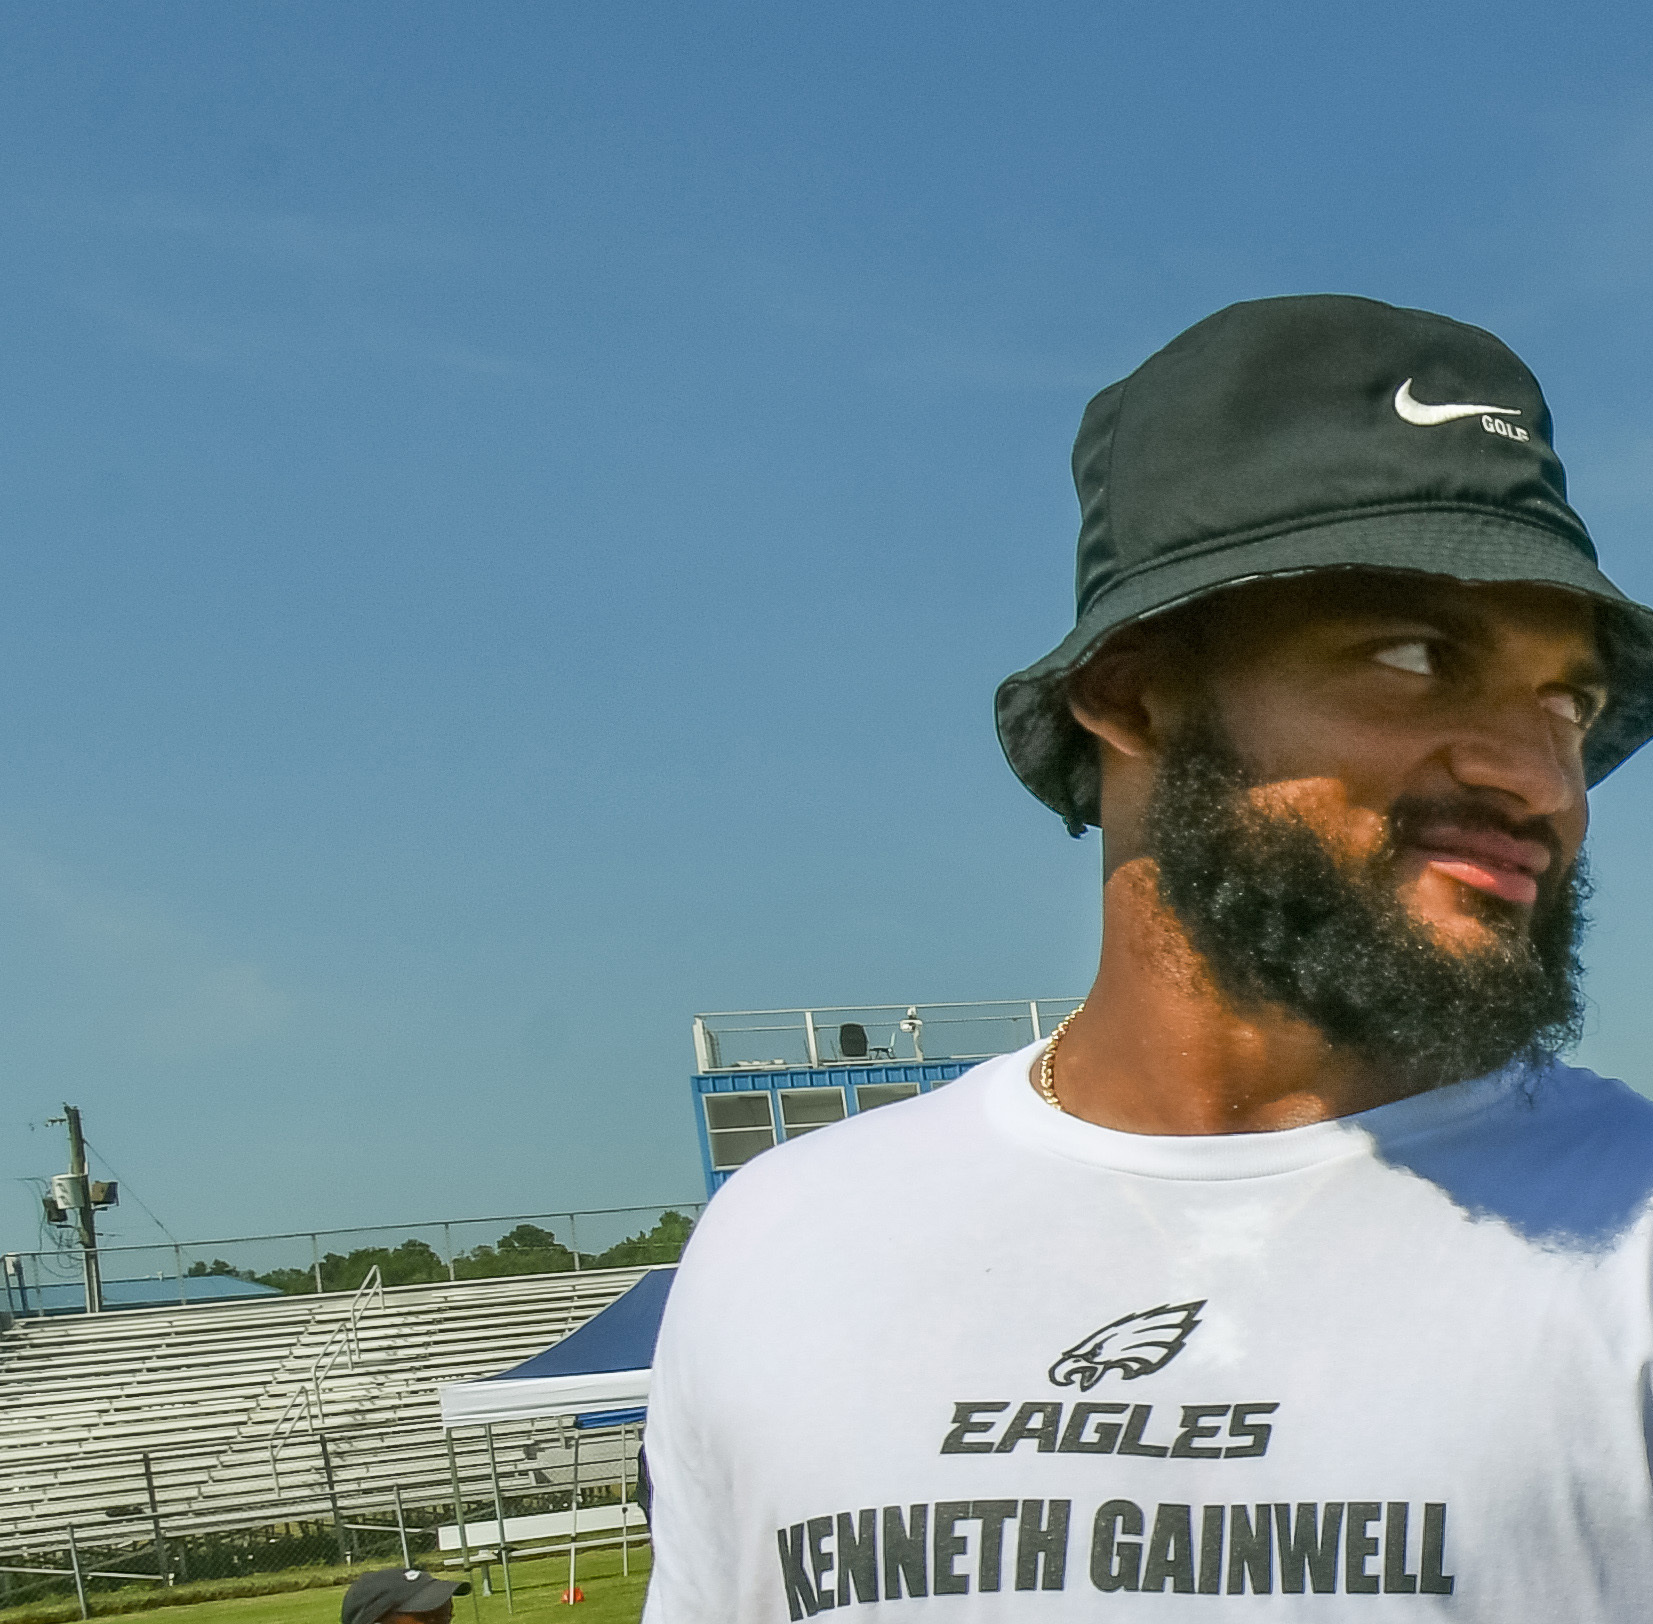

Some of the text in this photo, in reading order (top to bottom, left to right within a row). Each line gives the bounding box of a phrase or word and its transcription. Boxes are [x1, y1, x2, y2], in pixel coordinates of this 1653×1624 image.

[1482, 415, 1529, 441] GOLF
[939, 1402, 1280, 1458] EAGLES
[777, 1499, 1456, 1622] KENNETH GAINWELL
